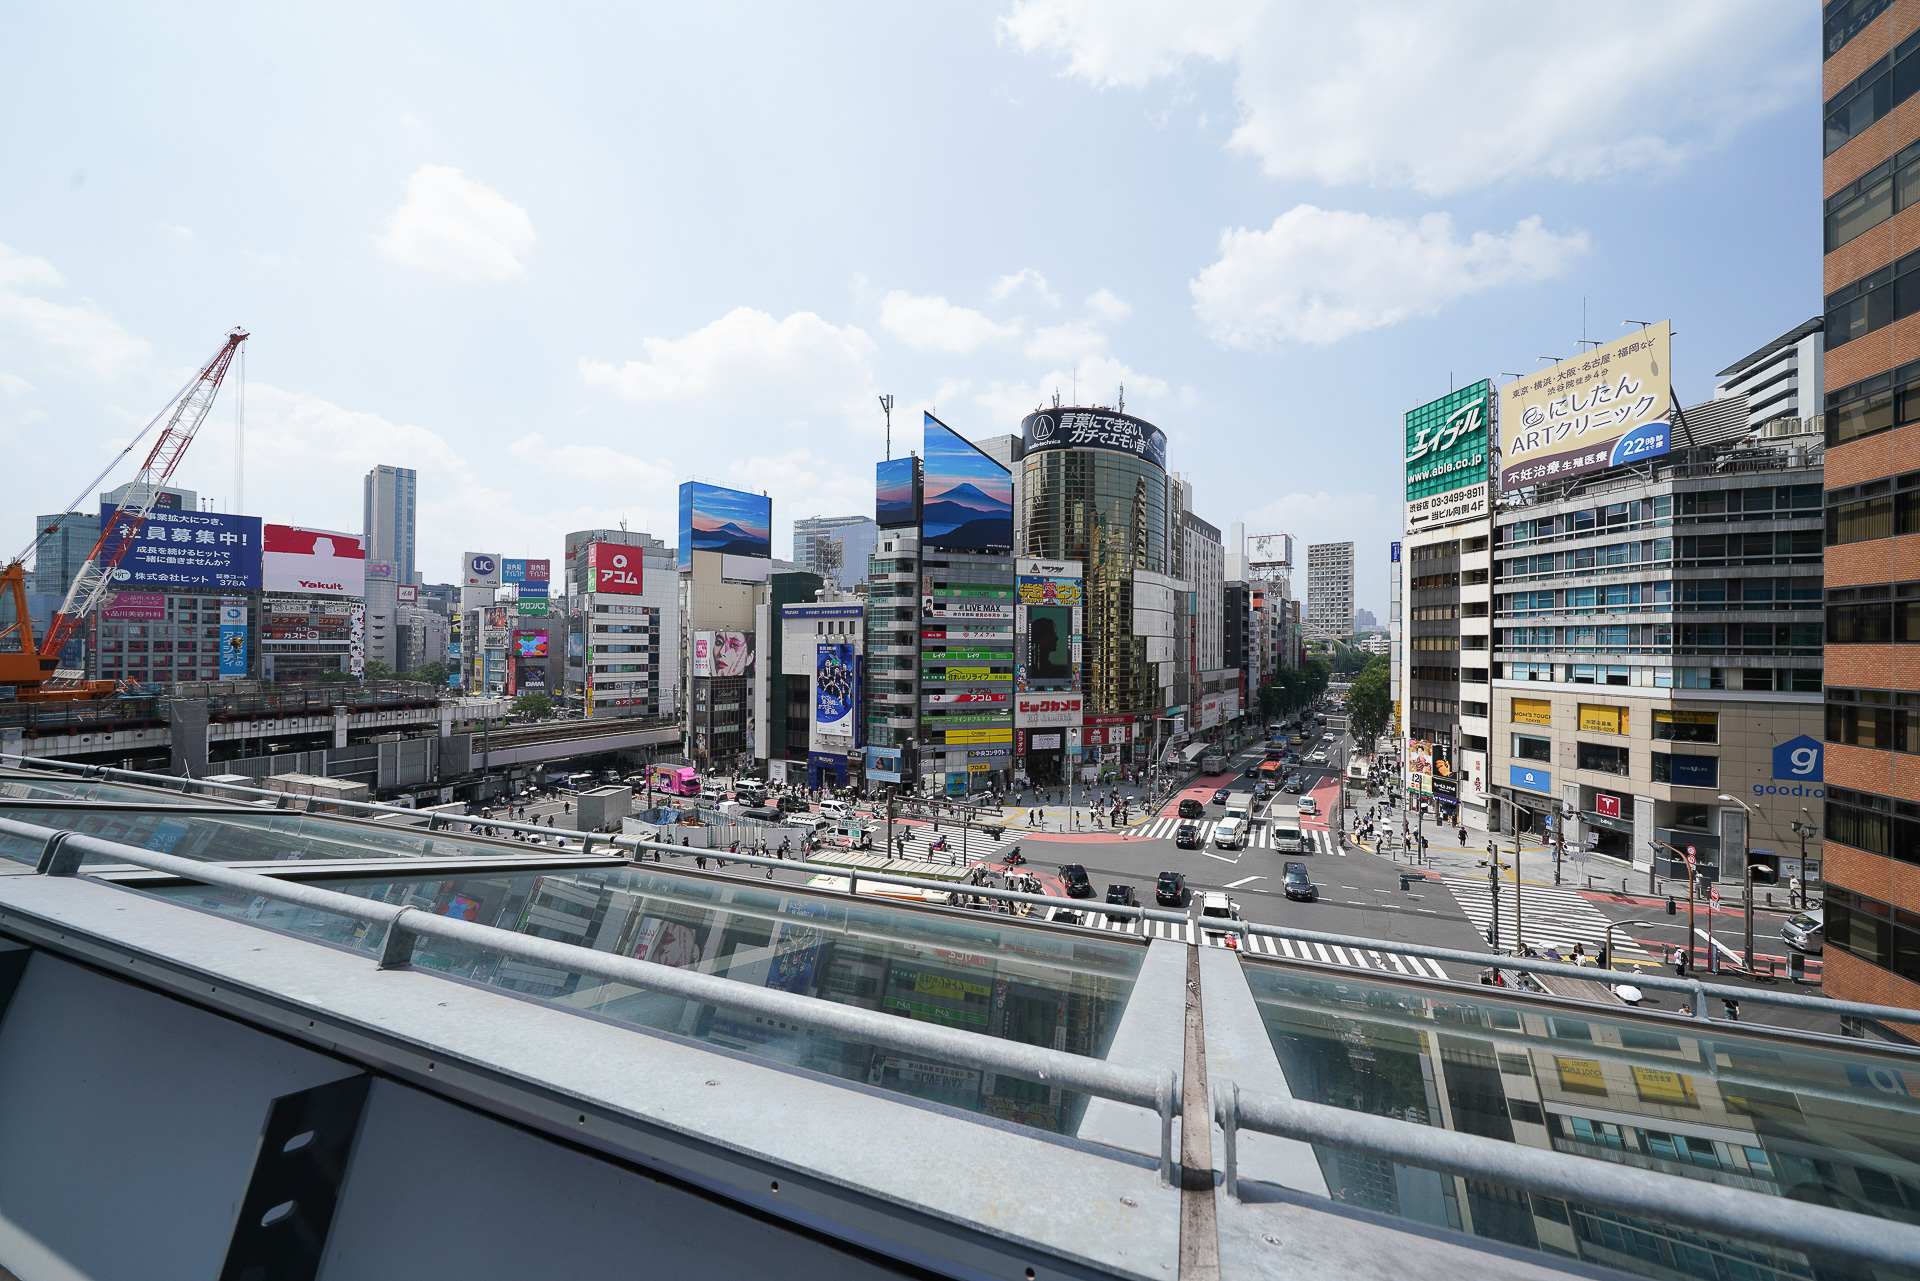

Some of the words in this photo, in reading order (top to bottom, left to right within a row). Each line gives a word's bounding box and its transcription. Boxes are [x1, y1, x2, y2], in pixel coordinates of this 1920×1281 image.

[1512, 338, 1655, 399] 東京・横浜・大阪・名古屋・福岡など
[1549, 376, 1639, 420] にしたん
[1059, 413, 1144, 438] 言葉にできない、
[1404, 397, 1484, 464] エイブル
[1511, 395, 1655, 455] ARTクリニック
[1028, 439, 1060, 450] audio-technica
[1068, 428, 1146, 454] ガチでエモい音
[1408, 452, 1482, 483] www.able.co.jp
[1410, 500, 1429, 513] 渋谷店
[1431, 486, 1484, 508] 03-3499-8911
[1432, 504, 1470, 520] 当ビル向側
[1470, 500, 1484, 512] 4F
[136, 546, 230, 558] 成長を続けるヒットで
[136, 556, 231, 567] 一緒に働きませんか?
[473, 560, 494, 571] UC
[135, 572, 209, 583] 株式会社ヒット
[298, 580, 343, 590] Yakult
[601, 570, 638, 584] アコム
[1020, 700, 1080, 712] ビックカメラ
[1040, 714, 1072, 722] CAMERA
